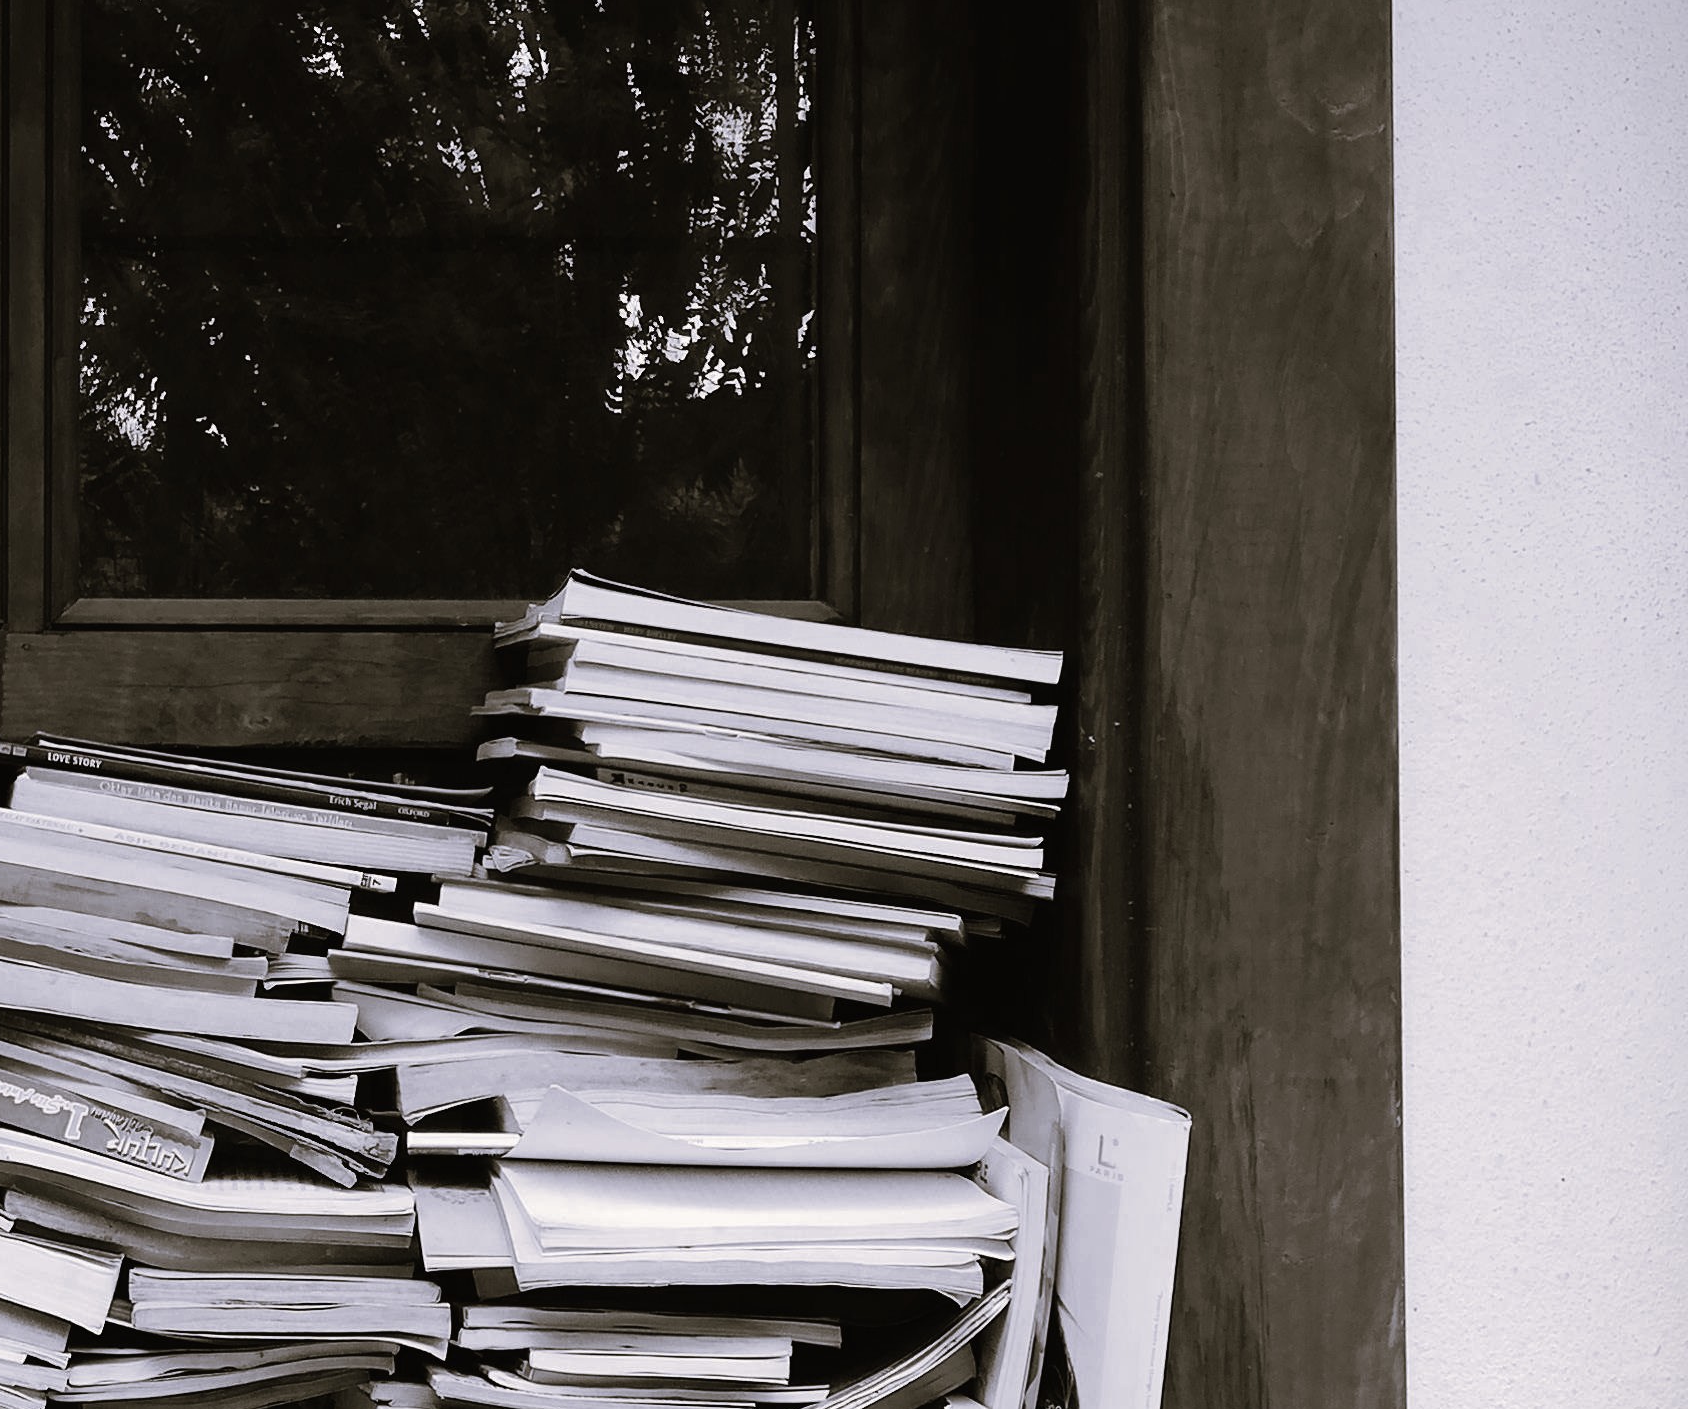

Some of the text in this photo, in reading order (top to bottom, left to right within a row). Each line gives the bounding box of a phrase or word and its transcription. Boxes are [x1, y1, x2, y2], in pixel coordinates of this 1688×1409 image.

[46, 751, 102, 769] LOVE STORY
[328, 793, 377, 811] Erich Segal
